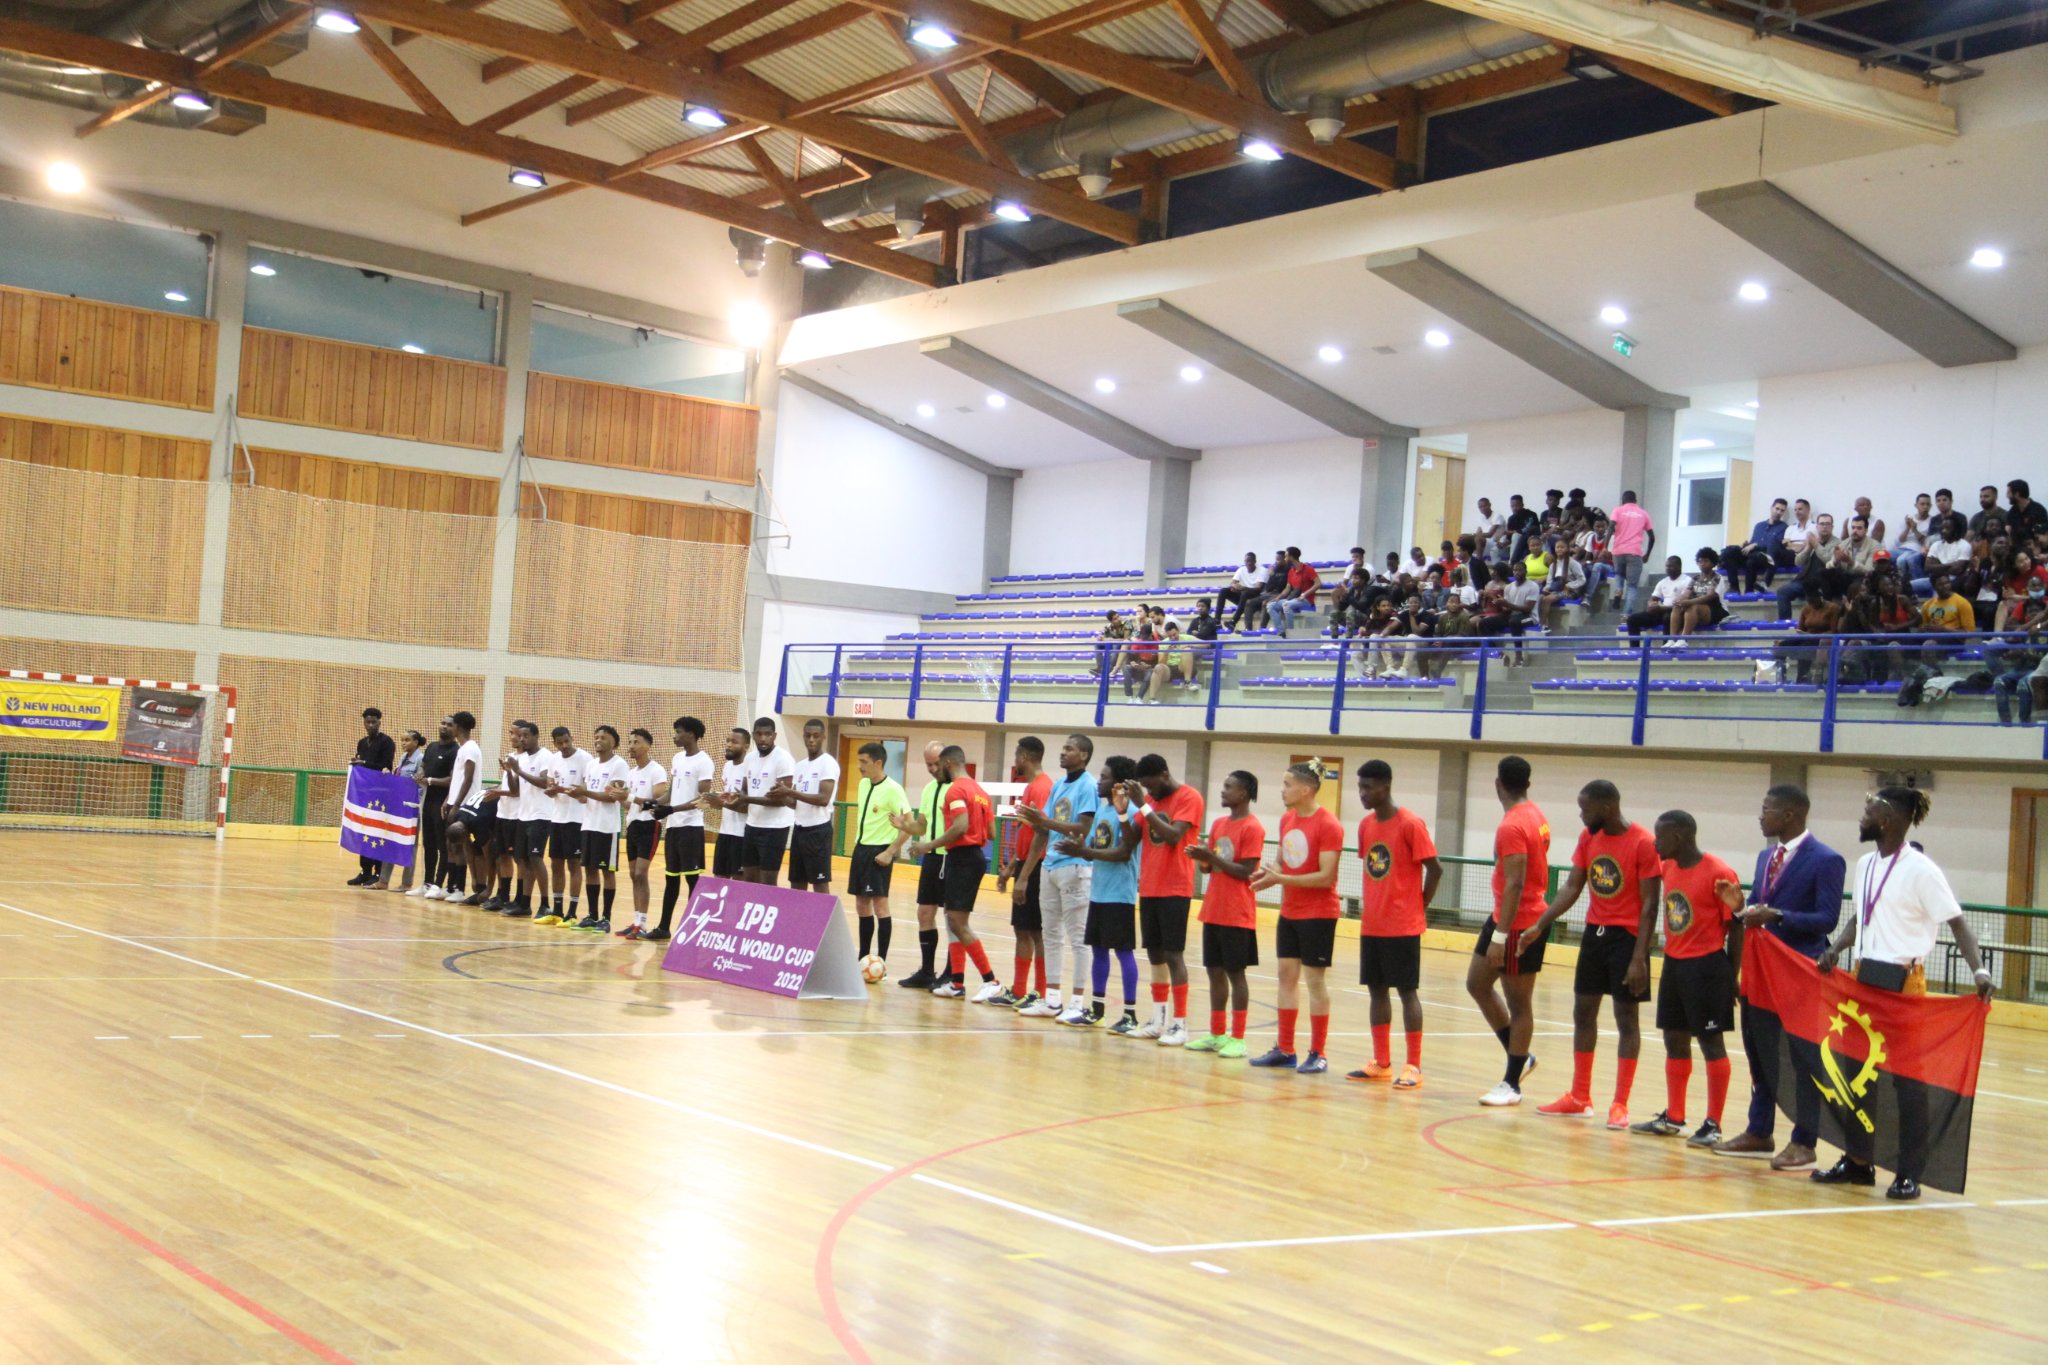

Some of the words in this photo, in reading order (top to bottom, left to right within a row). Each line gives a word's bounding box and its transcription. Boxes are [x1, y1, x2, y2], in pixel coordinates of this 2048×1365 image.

[23, 702, 49, 711] NEW
[51, 704, 102, 715] HOLLAND
[21, 717, 82, 728] AGRICULTURE
[735, 901, 779, 935] IPB
[696, 930, 738, 953] FUTSAL
[739, 937, 785, 962] WORLD
[784, 946, 815, 968] CUP
[773, 971, 803, 991] 2022
